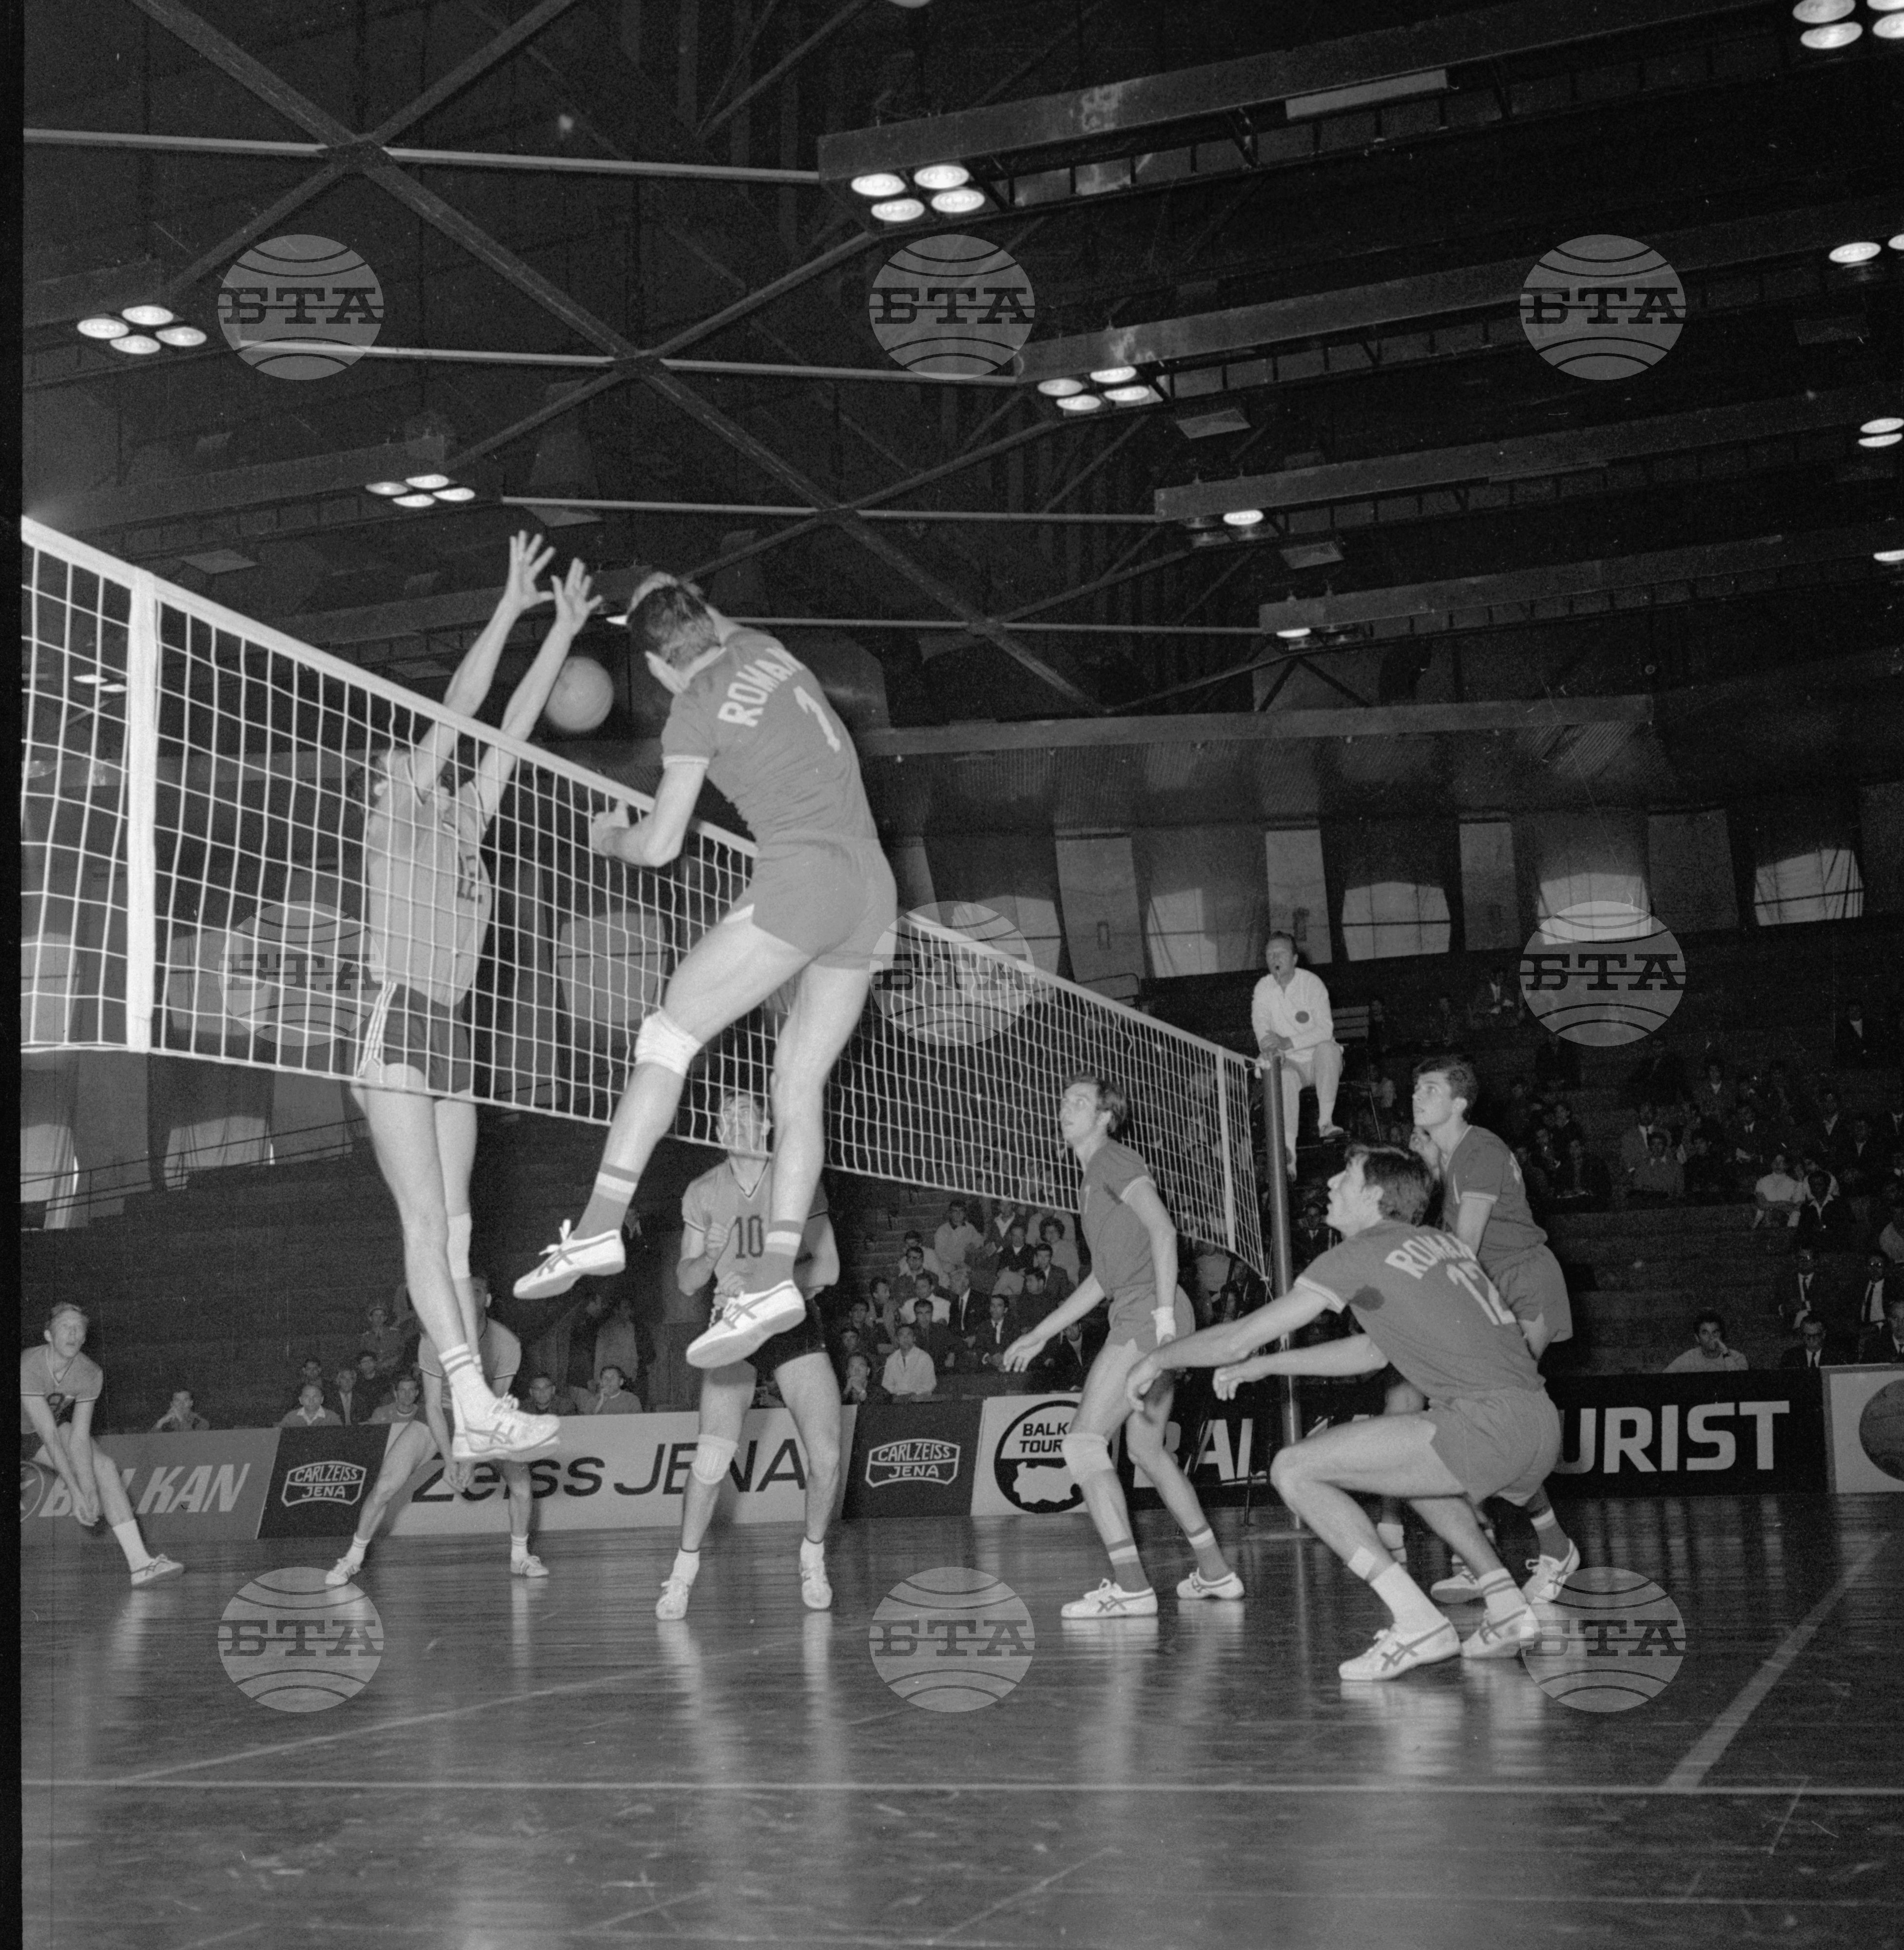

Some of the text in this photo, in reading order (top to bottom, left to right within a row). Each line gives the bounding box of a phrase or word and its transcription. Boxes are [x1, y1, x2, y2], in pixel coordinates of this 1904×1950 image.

[793, 685, 840, 752] 1
[735, 1214, 763, 1259] 10
[1023, 1423, 1069, 1436] BALK
[1553, 1400, 1790, 1475] URIST
[1019, 1439, 1064, 1453] TOUR
[411, 1438, 806, 1502] Zess JENA
[888, 1464, 939, 1478] JENA
[301, 1485, 346, 1499] JENA
